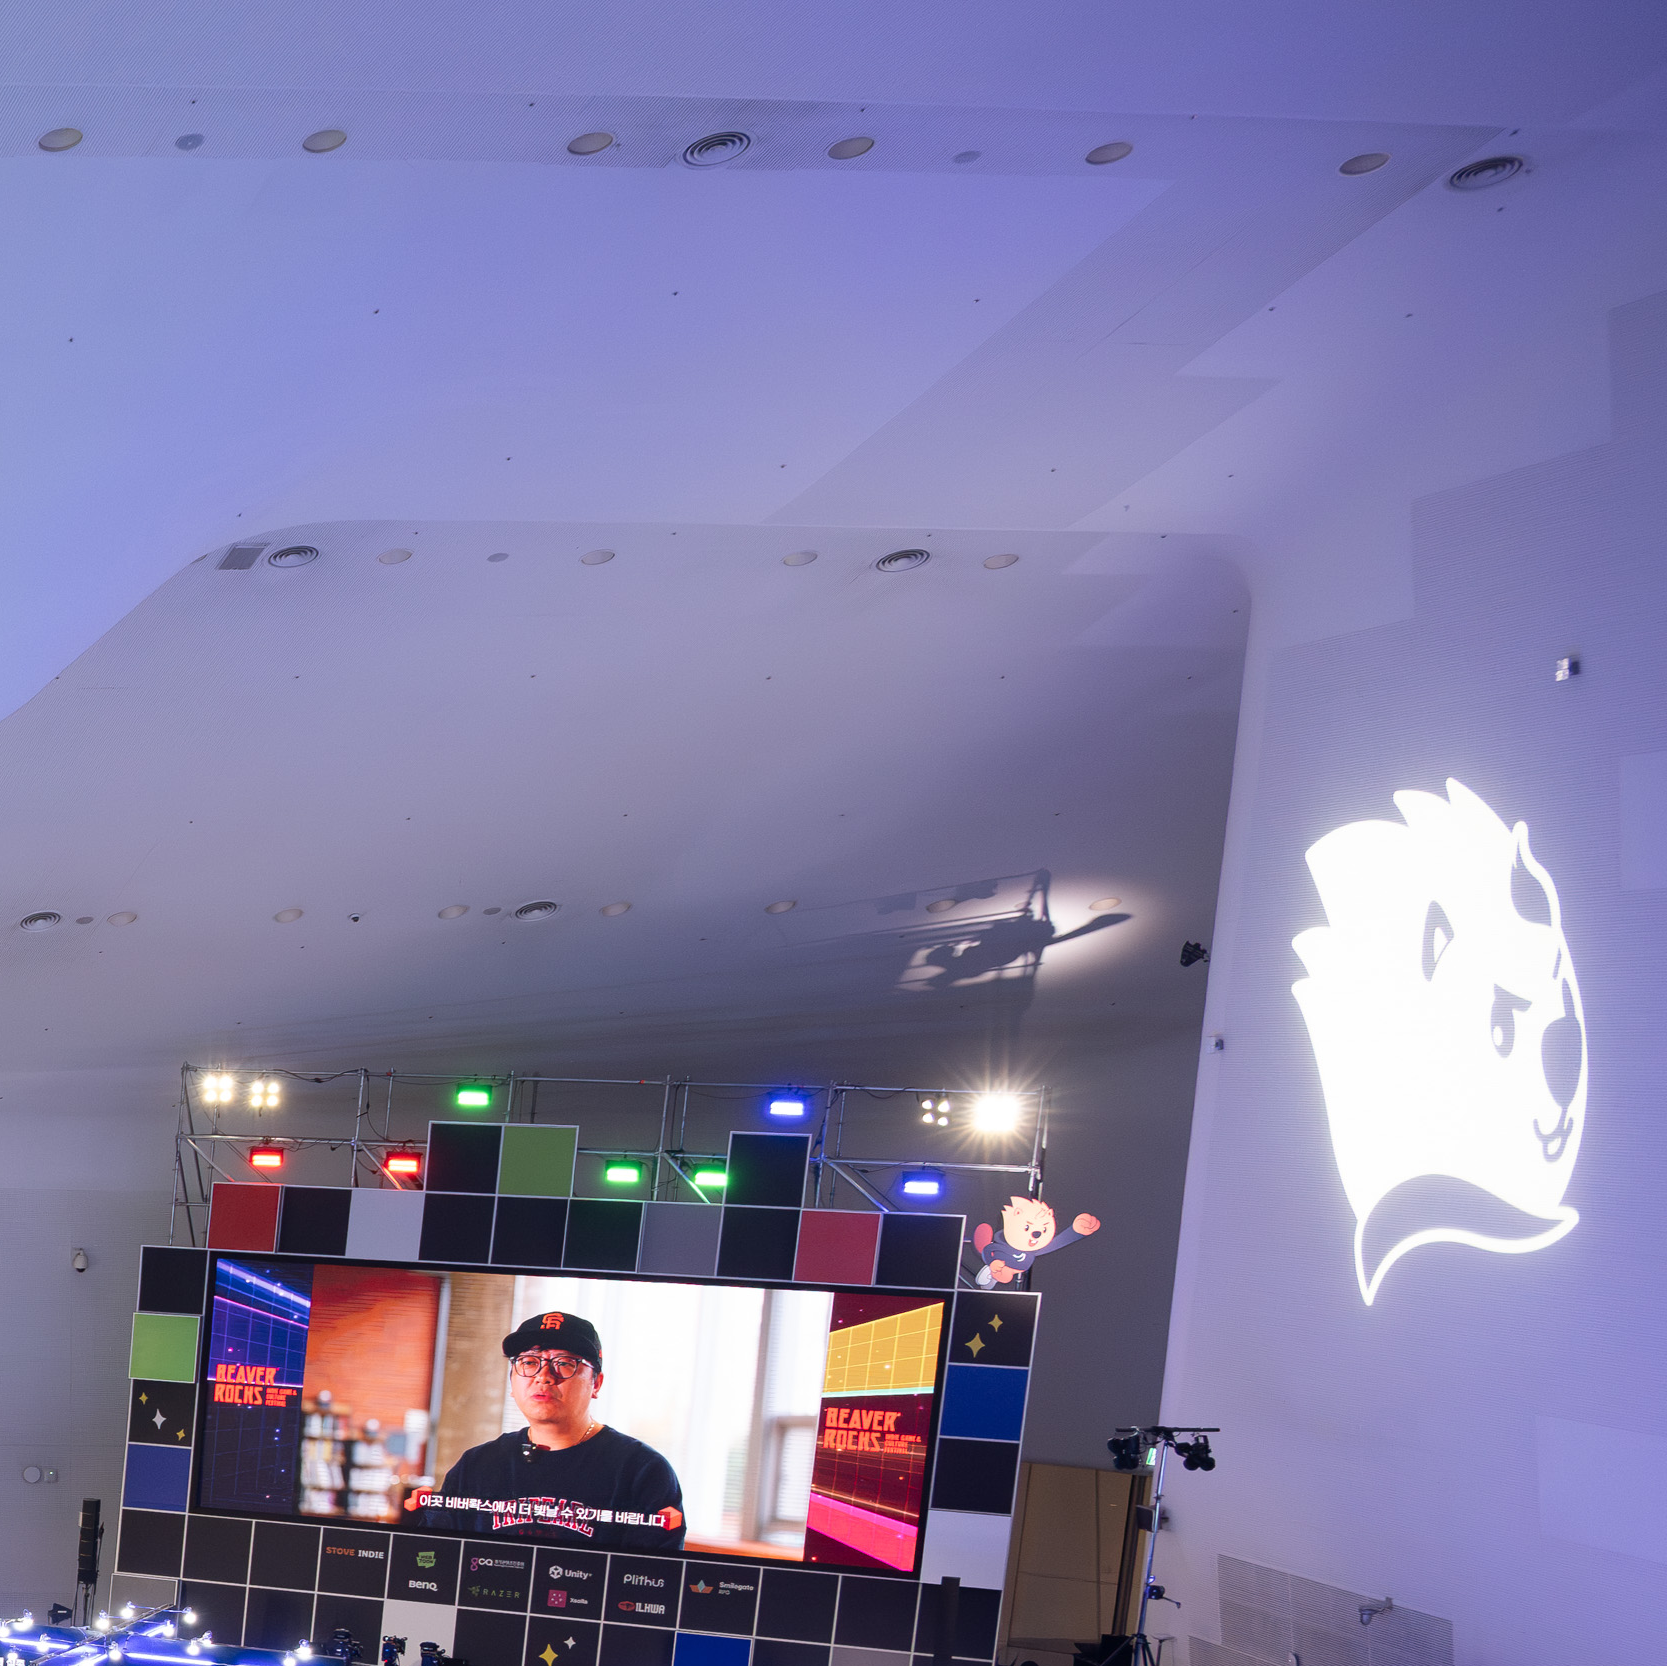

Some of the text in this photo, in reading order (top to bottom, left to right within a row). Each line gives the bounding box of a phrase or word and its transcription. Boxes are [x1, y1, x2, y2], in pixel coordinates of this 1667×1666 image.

[419, 1494, 443, 1508] 이곳
[519, 1502, 531, 1516] 더
[533, 1504, 559, 1518] 빛날
[561, 1507, 573, 1518] 수
[576, 1508, 613, 1522] 있기를
[615, 1511, 665, 1527] 바랍니다
[326, 1546, 385, 1559] STOVE INDIE
[565, 1569, 590, 1580] Unity
